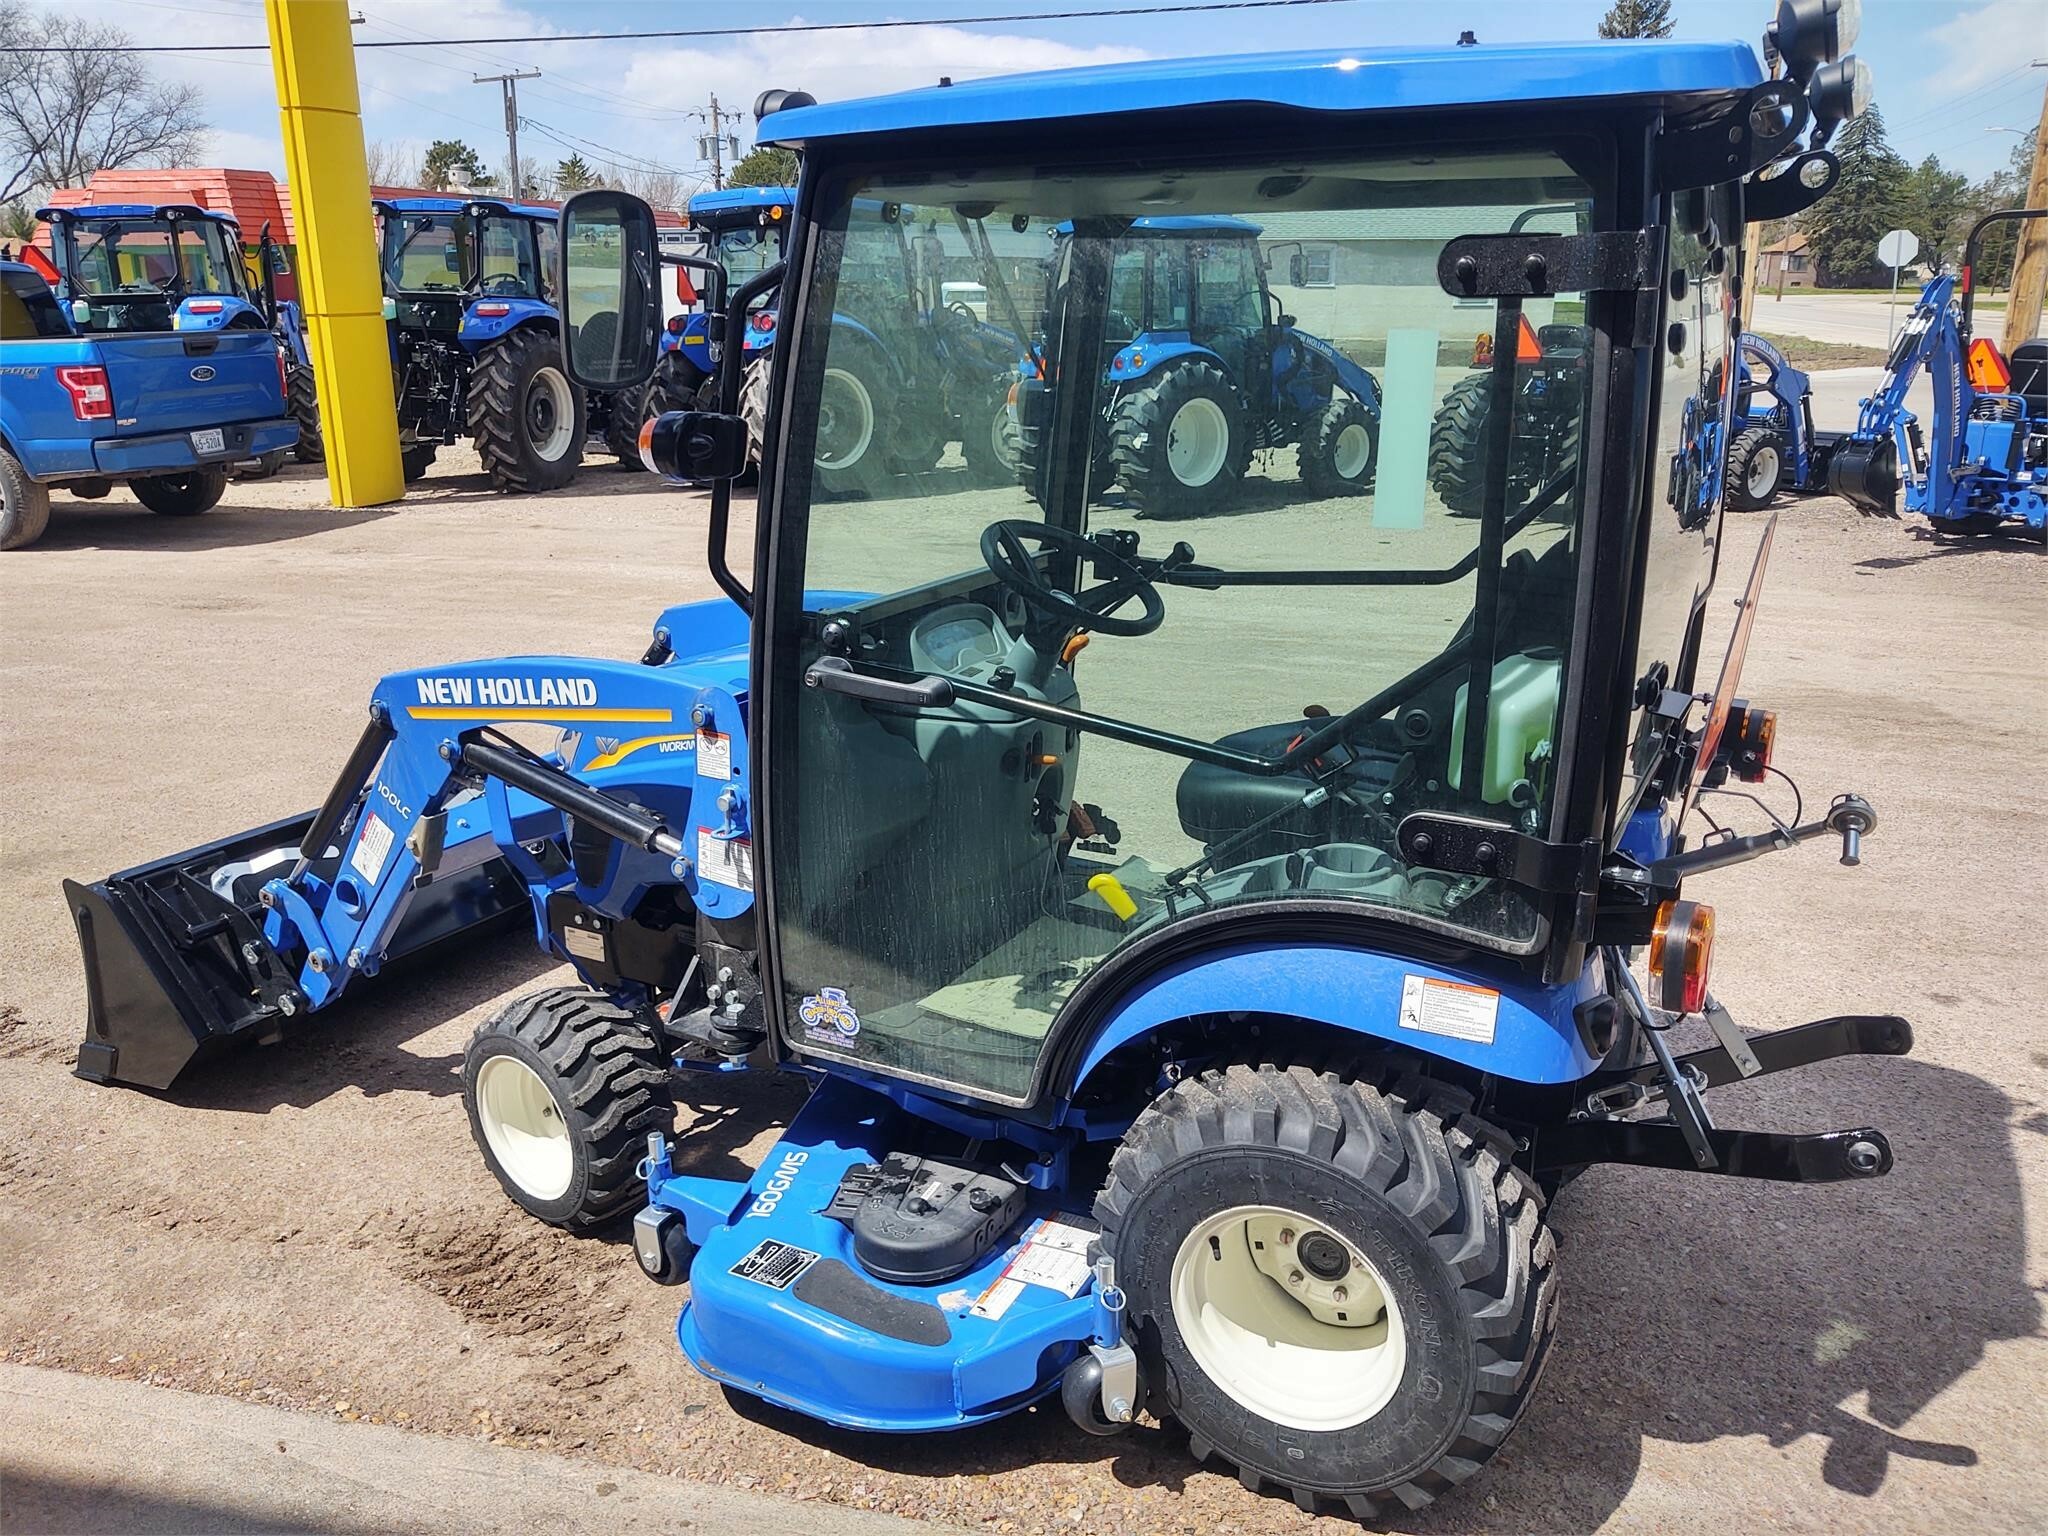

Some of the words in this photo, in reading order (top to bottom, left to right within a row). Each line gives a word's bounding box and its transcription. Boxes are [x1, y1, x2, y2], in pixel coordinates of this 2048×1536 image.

[1741, 334, 1755, 345] NEW
[1755, 337, 1780, 364] HOLLAND
[1953, 388, 1961, 437] HOLLAND
[416, 677, 472, 704] NEW
[476, 677, 598, 706] HOLLAND
[377, 780, 412, 820] 100LC
[746, 1151, 810, 1219] 160GMS
